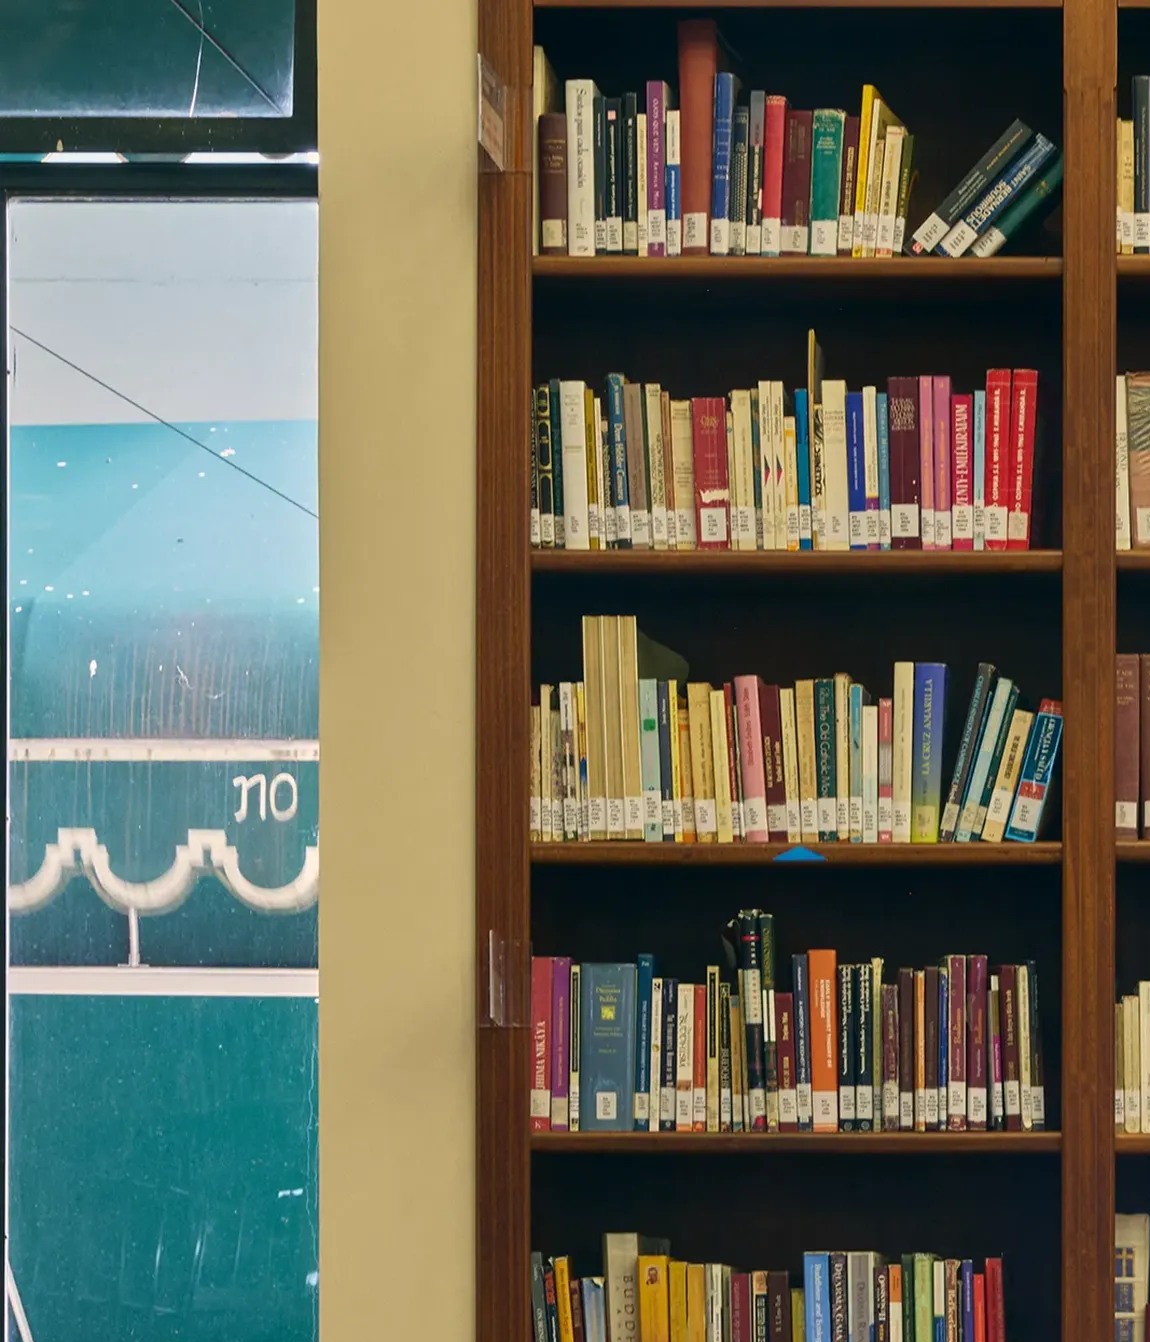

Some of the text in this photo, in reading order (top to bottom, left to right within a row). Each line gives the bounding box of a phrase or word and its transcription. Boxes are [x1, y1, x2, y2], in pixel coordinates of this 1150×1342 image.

[963, 179, 1007, 224] SOUBIROUS
[969, 163, 1033, 230] SAINT BERNADETT
[820, 704, 829, 721] The
[821, 722, 830, 740] Old
[922, 679, 932, 776] LA CRUZ AMARILLA
[815, 1263, 823, 1301] Buddhism
[833, 1262, 844, 1312] DHARMA
